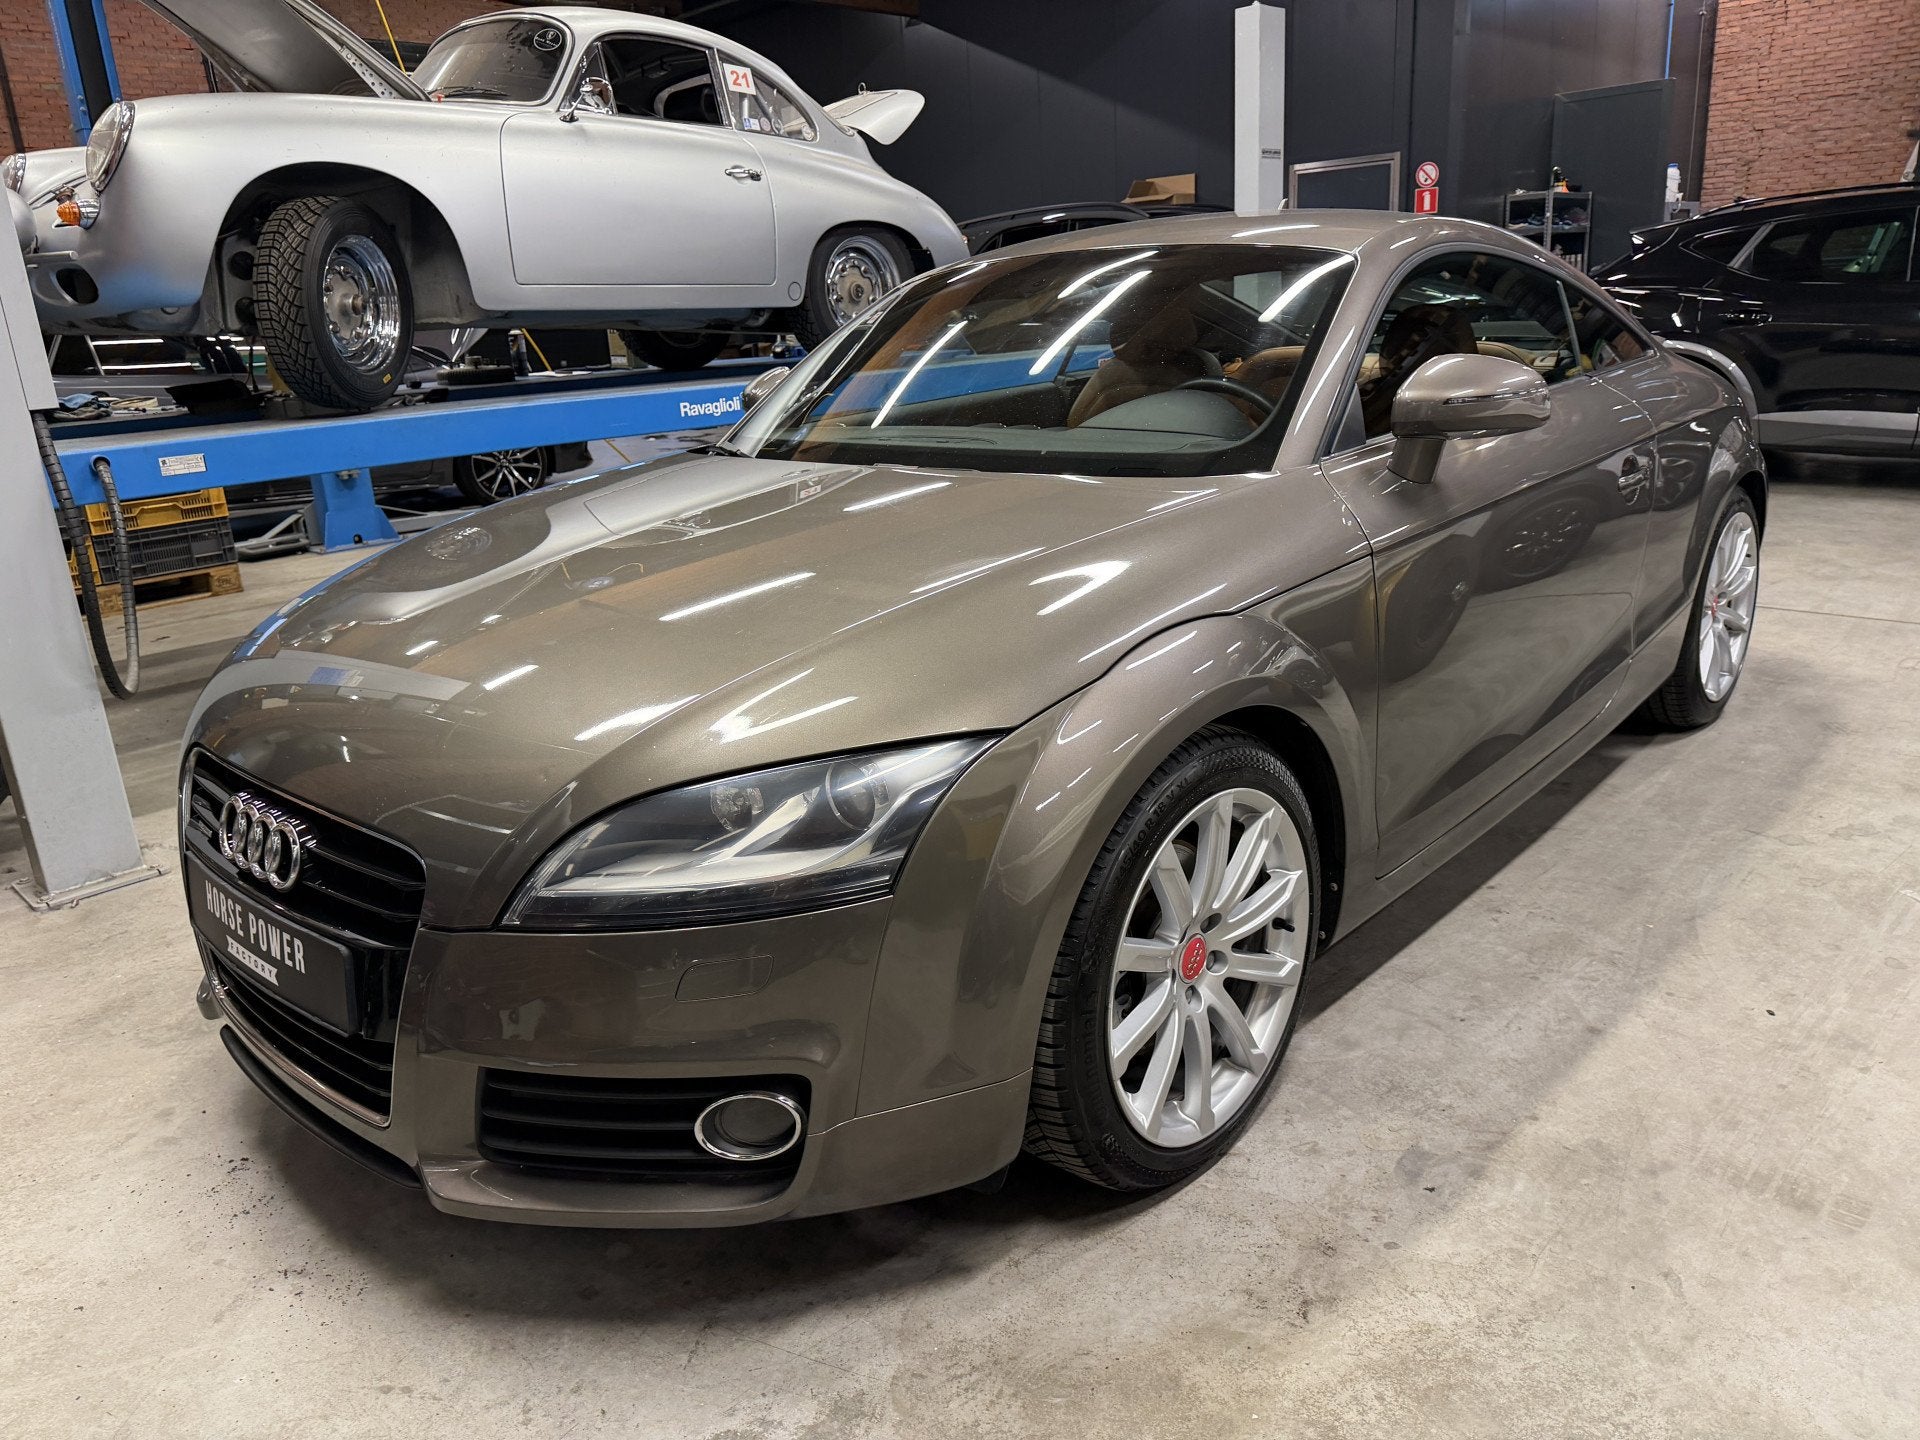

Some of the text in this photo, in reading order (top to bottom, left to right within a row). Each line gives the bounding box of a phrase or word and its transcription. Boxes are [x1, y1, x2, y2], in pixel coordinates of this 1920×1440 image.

[730, 70, 750, 88] 21
[680, 396, 740, 417] Ravaglioli
[205, 880, 306, 974] HORSE POWER
[230, 941, 274, 978] FACTORY
